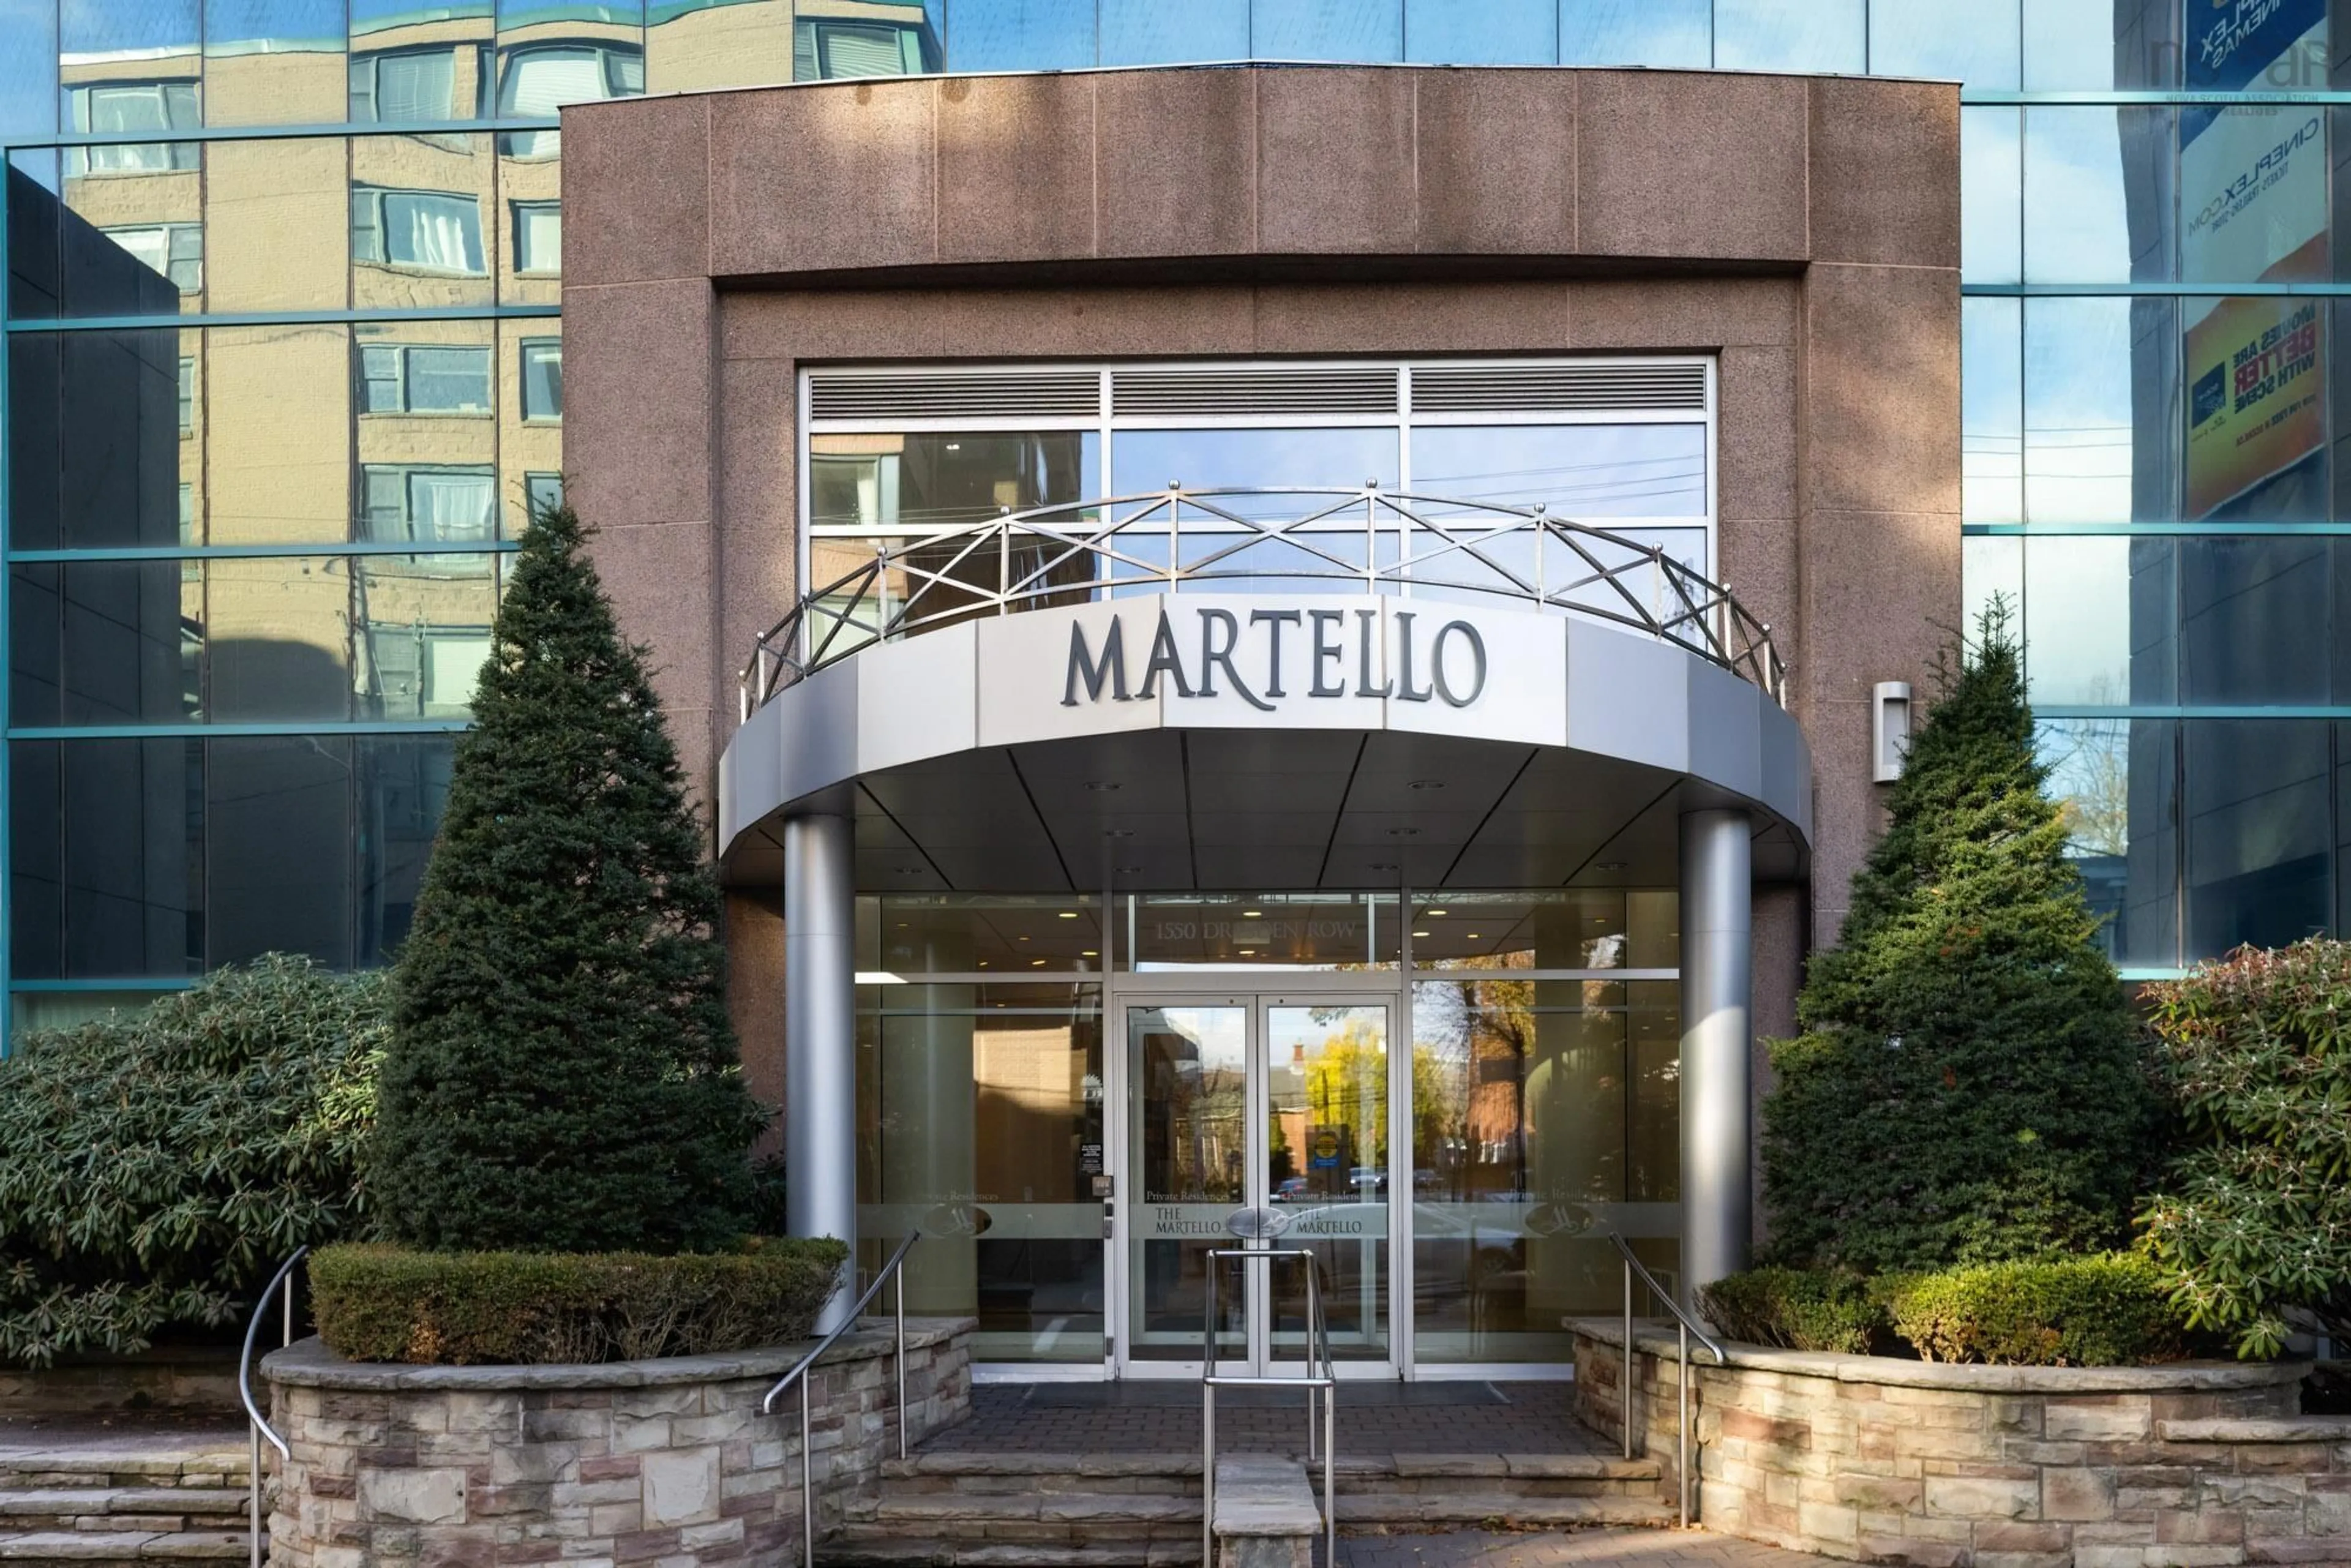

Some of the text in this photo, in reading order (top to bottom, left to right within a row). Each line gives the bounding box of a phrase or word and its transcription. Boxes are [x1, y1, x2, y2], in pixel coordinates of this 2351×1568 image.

[1060, 608, 1488, 711] MARTELLO
[1157, 921, 1197, 939] 1550
[1308, 920, 1357, 939] ROW
[1146, 1190, 1179, 1201] Private
[1155, 1207, 1181, 1220] THE
[1155, 1221, 1221, 1234] MARTELLO
[1296, 1220, 1362, 1234] MARTELLO
